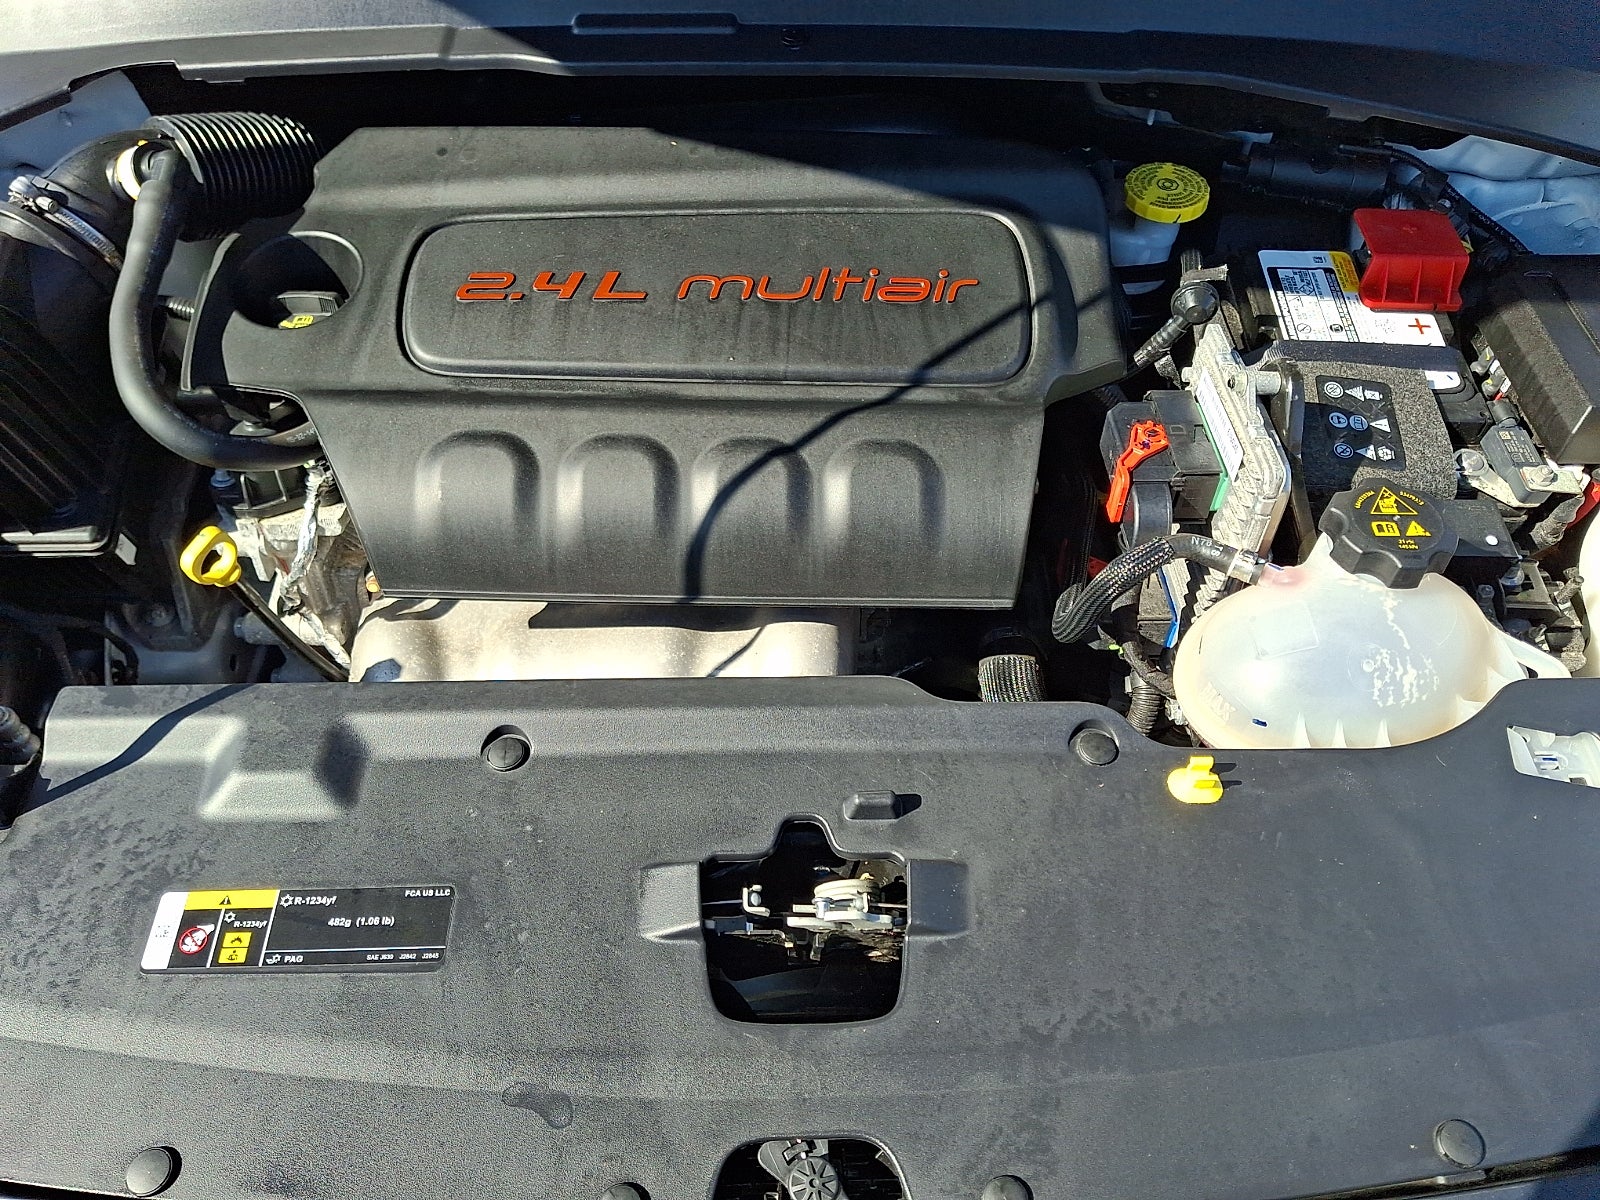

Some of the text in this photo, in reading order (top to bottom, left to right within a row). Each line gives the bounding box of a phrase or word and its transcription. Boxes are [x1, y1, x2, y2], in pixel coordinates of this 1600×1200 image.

[455, 267, 979, 303] 2.4L multiair
[404, 888, 450, 897] FCA US LLC
[294, 896, 337, 906] R-1234yf
[381, 916, 395, 927] lb)
[284, 955, 304, 963] PAG
